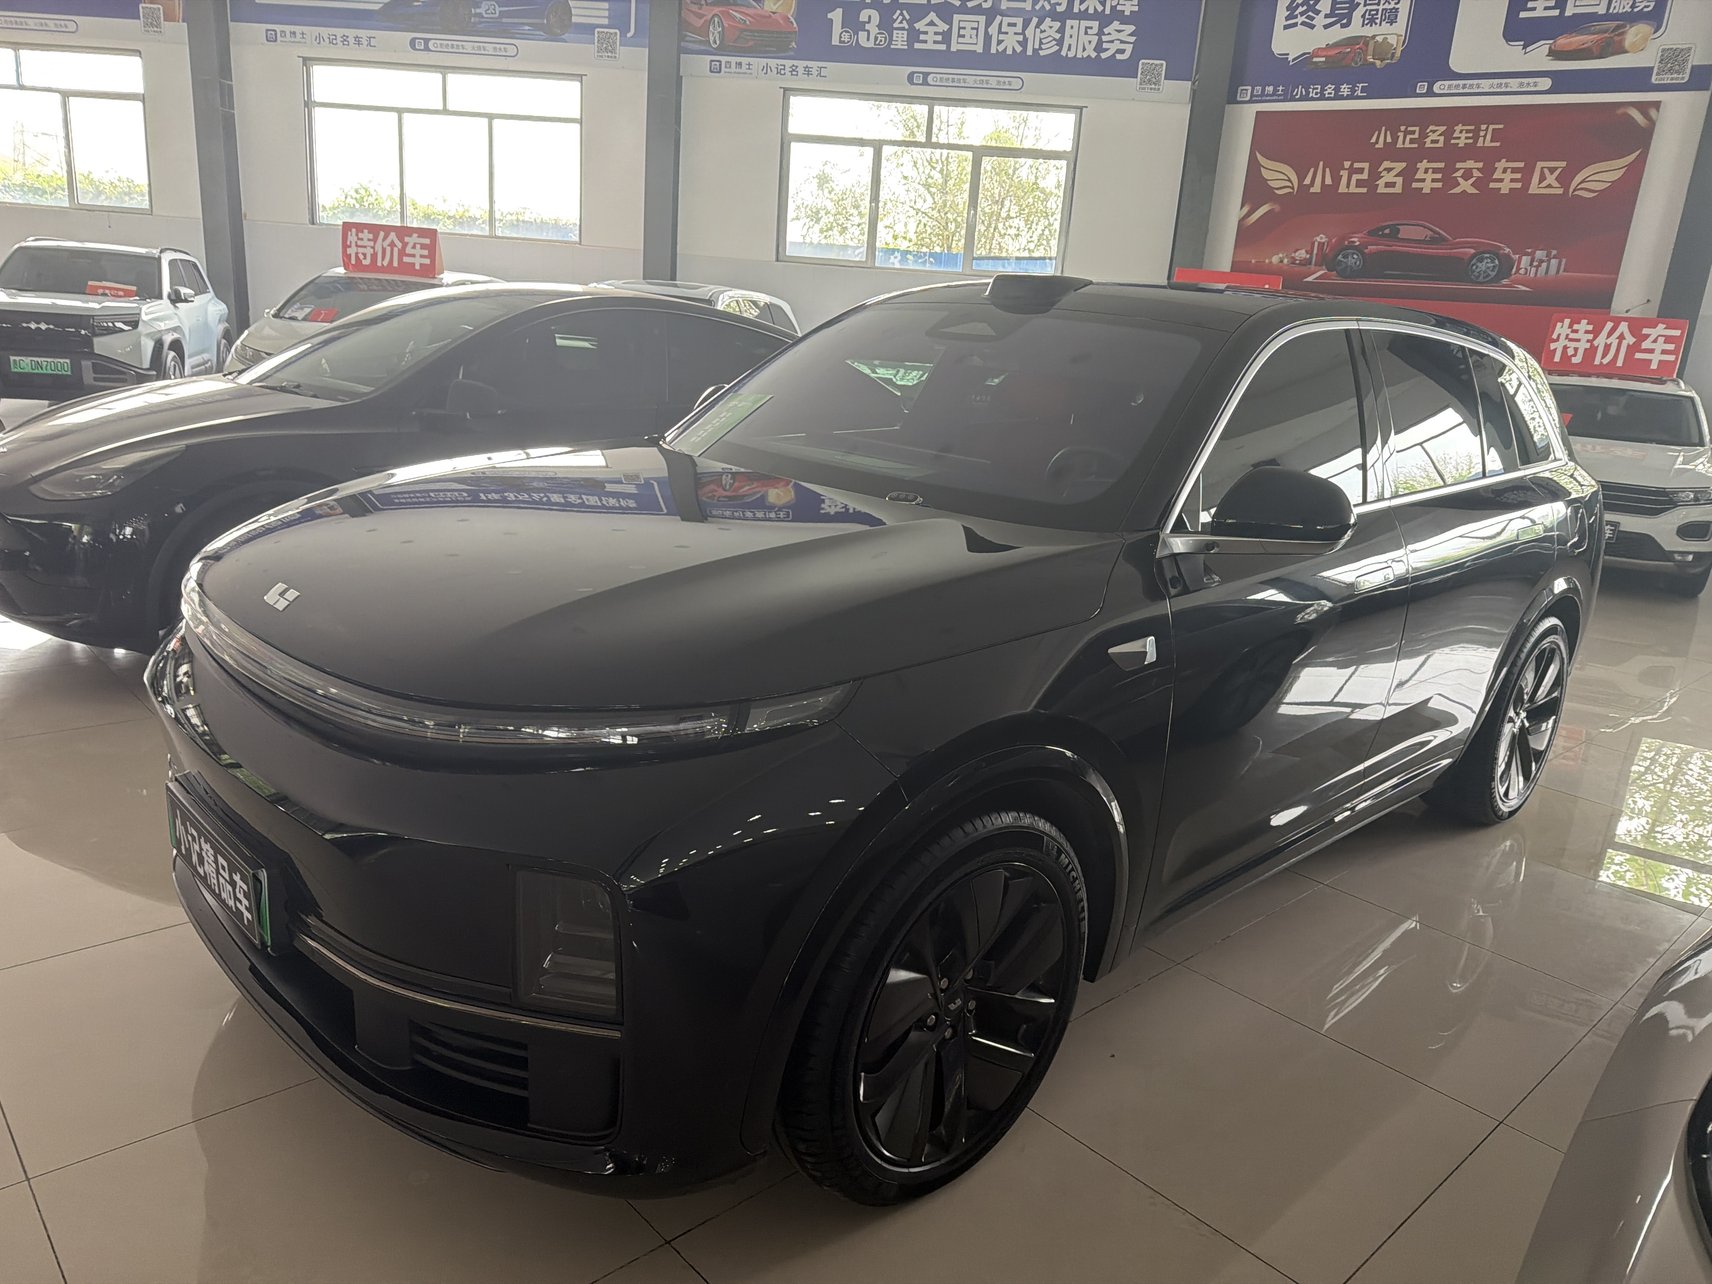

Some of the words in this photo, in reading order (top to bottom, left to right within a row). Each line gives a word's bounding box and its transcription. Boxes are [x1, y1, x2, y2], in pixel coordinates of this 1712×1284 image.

[1360, 7, 1400, 28] 保障
[314, 32, 377, 48] 小记名车汇
[761, 63, 828, 78] 小记名车汇
[1293, 83, 1369, 98] 小记名车汇
[1370, 124, 1504, 148] 小记名车汇
[1303, 159, 1568, 195] 小记名车交车区
[347, 228, 431, 270] 特价车
[1550, 318, 1682, 370] 特价车
[175, 808, 252, 926] 小记精品车
